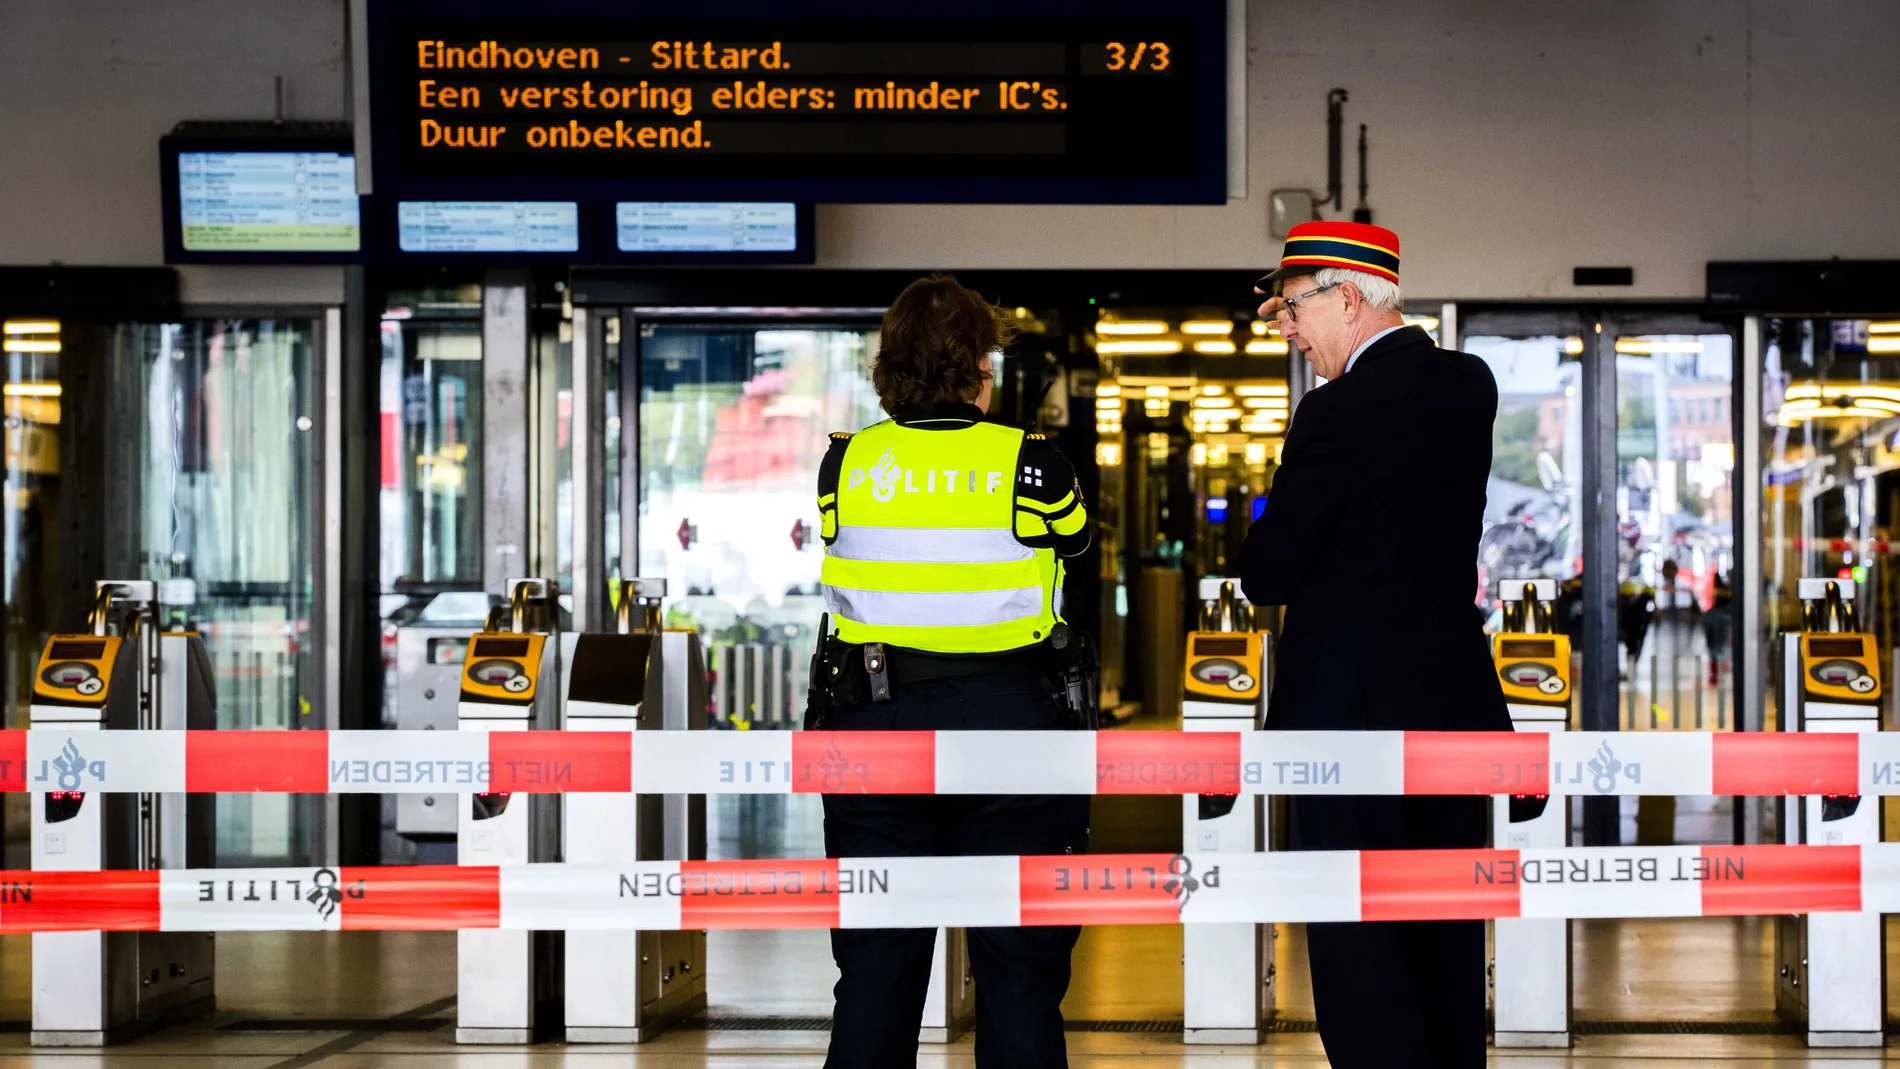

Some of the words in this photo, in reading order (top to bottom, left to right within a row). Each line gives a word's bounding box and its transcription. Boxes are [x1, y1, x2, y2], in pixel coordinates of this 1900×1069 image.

[417, 41, 600, 70] Eindhoven
[651, 41, 791, 70] Sittard.
[1105, 42, 1171, 71] 3/3
[419, 81, 481, 108] Een
[499, 81, 694, 116] verstoring
[711, 81, 836, 109] elders:
[854, 81, 980, 110] minder
[419, 120, 507, 148] Duur
[525, 120, 712, 149] onbekend.
[618, 869, 802, 898] BETREDEN
[813, 868, 890, 895] NIET
[1473, 858, 1659, 886] BETREDEN
[1669, 857, 1746, 882] NIET
